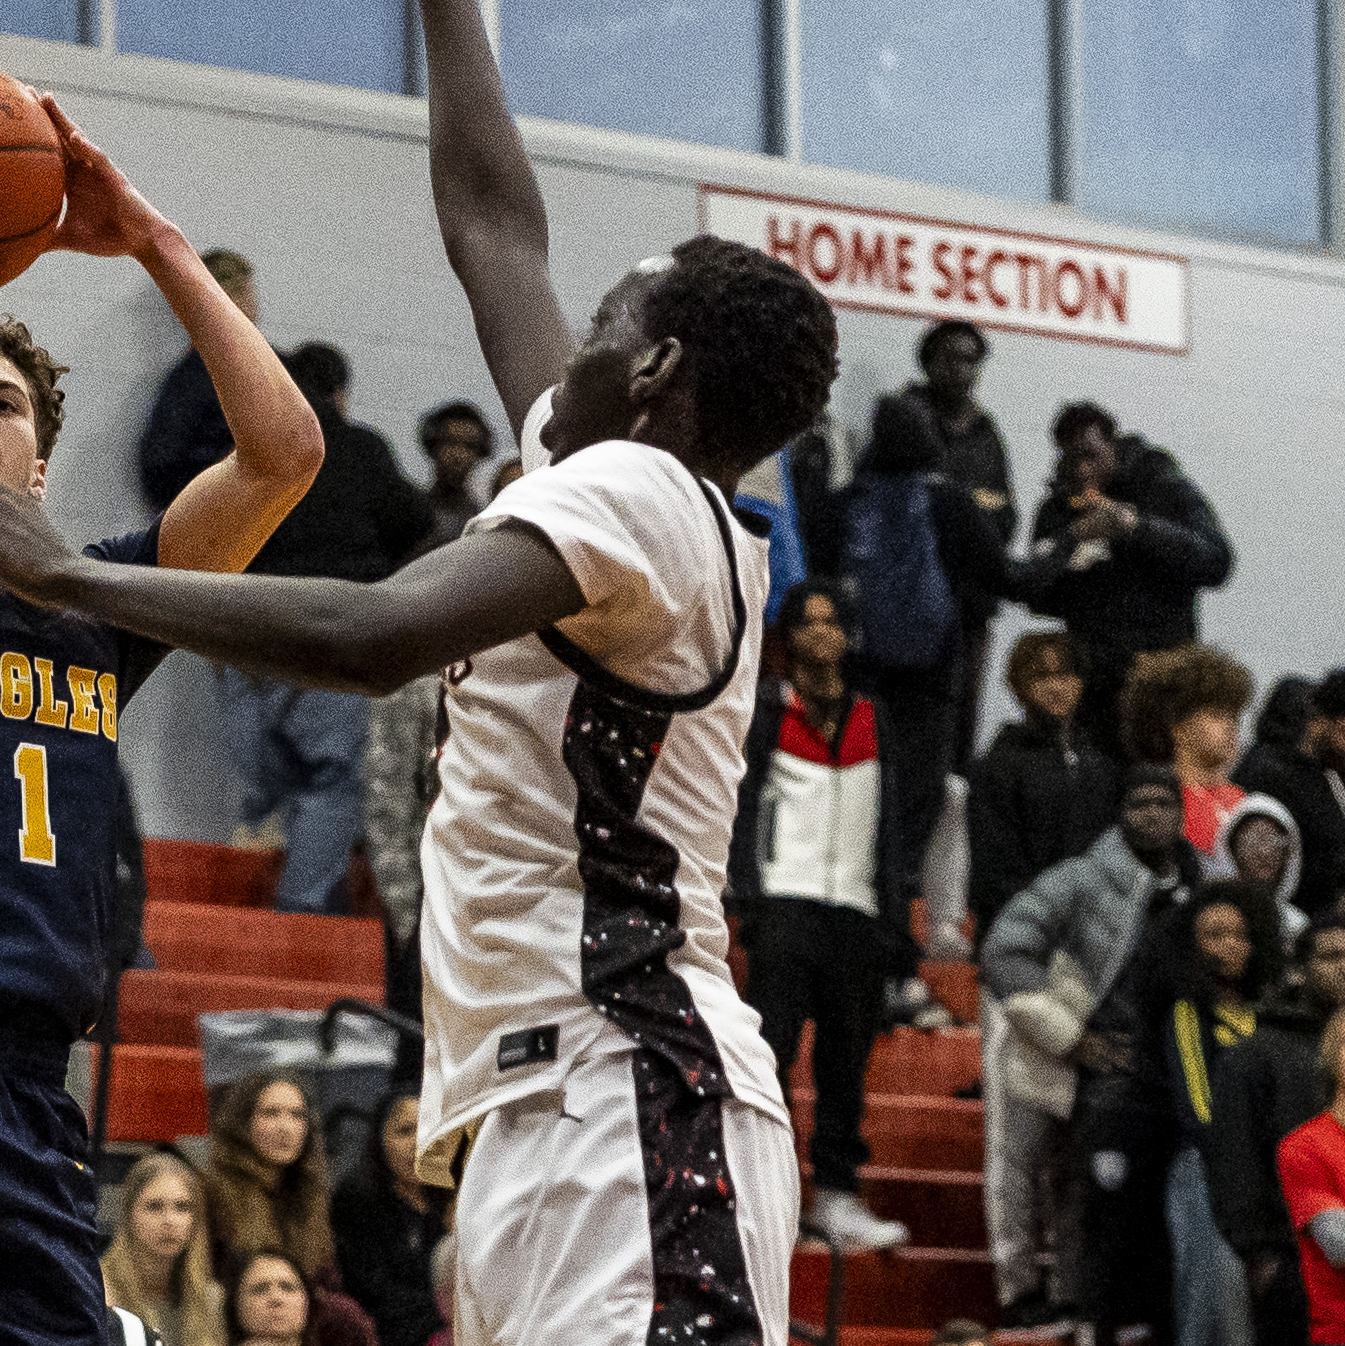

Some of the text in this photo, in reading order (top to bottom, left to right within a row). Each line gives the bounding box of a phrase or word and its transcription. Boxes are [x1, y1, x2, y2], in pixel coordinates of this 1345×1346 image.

[767, 216, 1128, 325] HOME SECTION
[13, 742, 57, 867] 1
